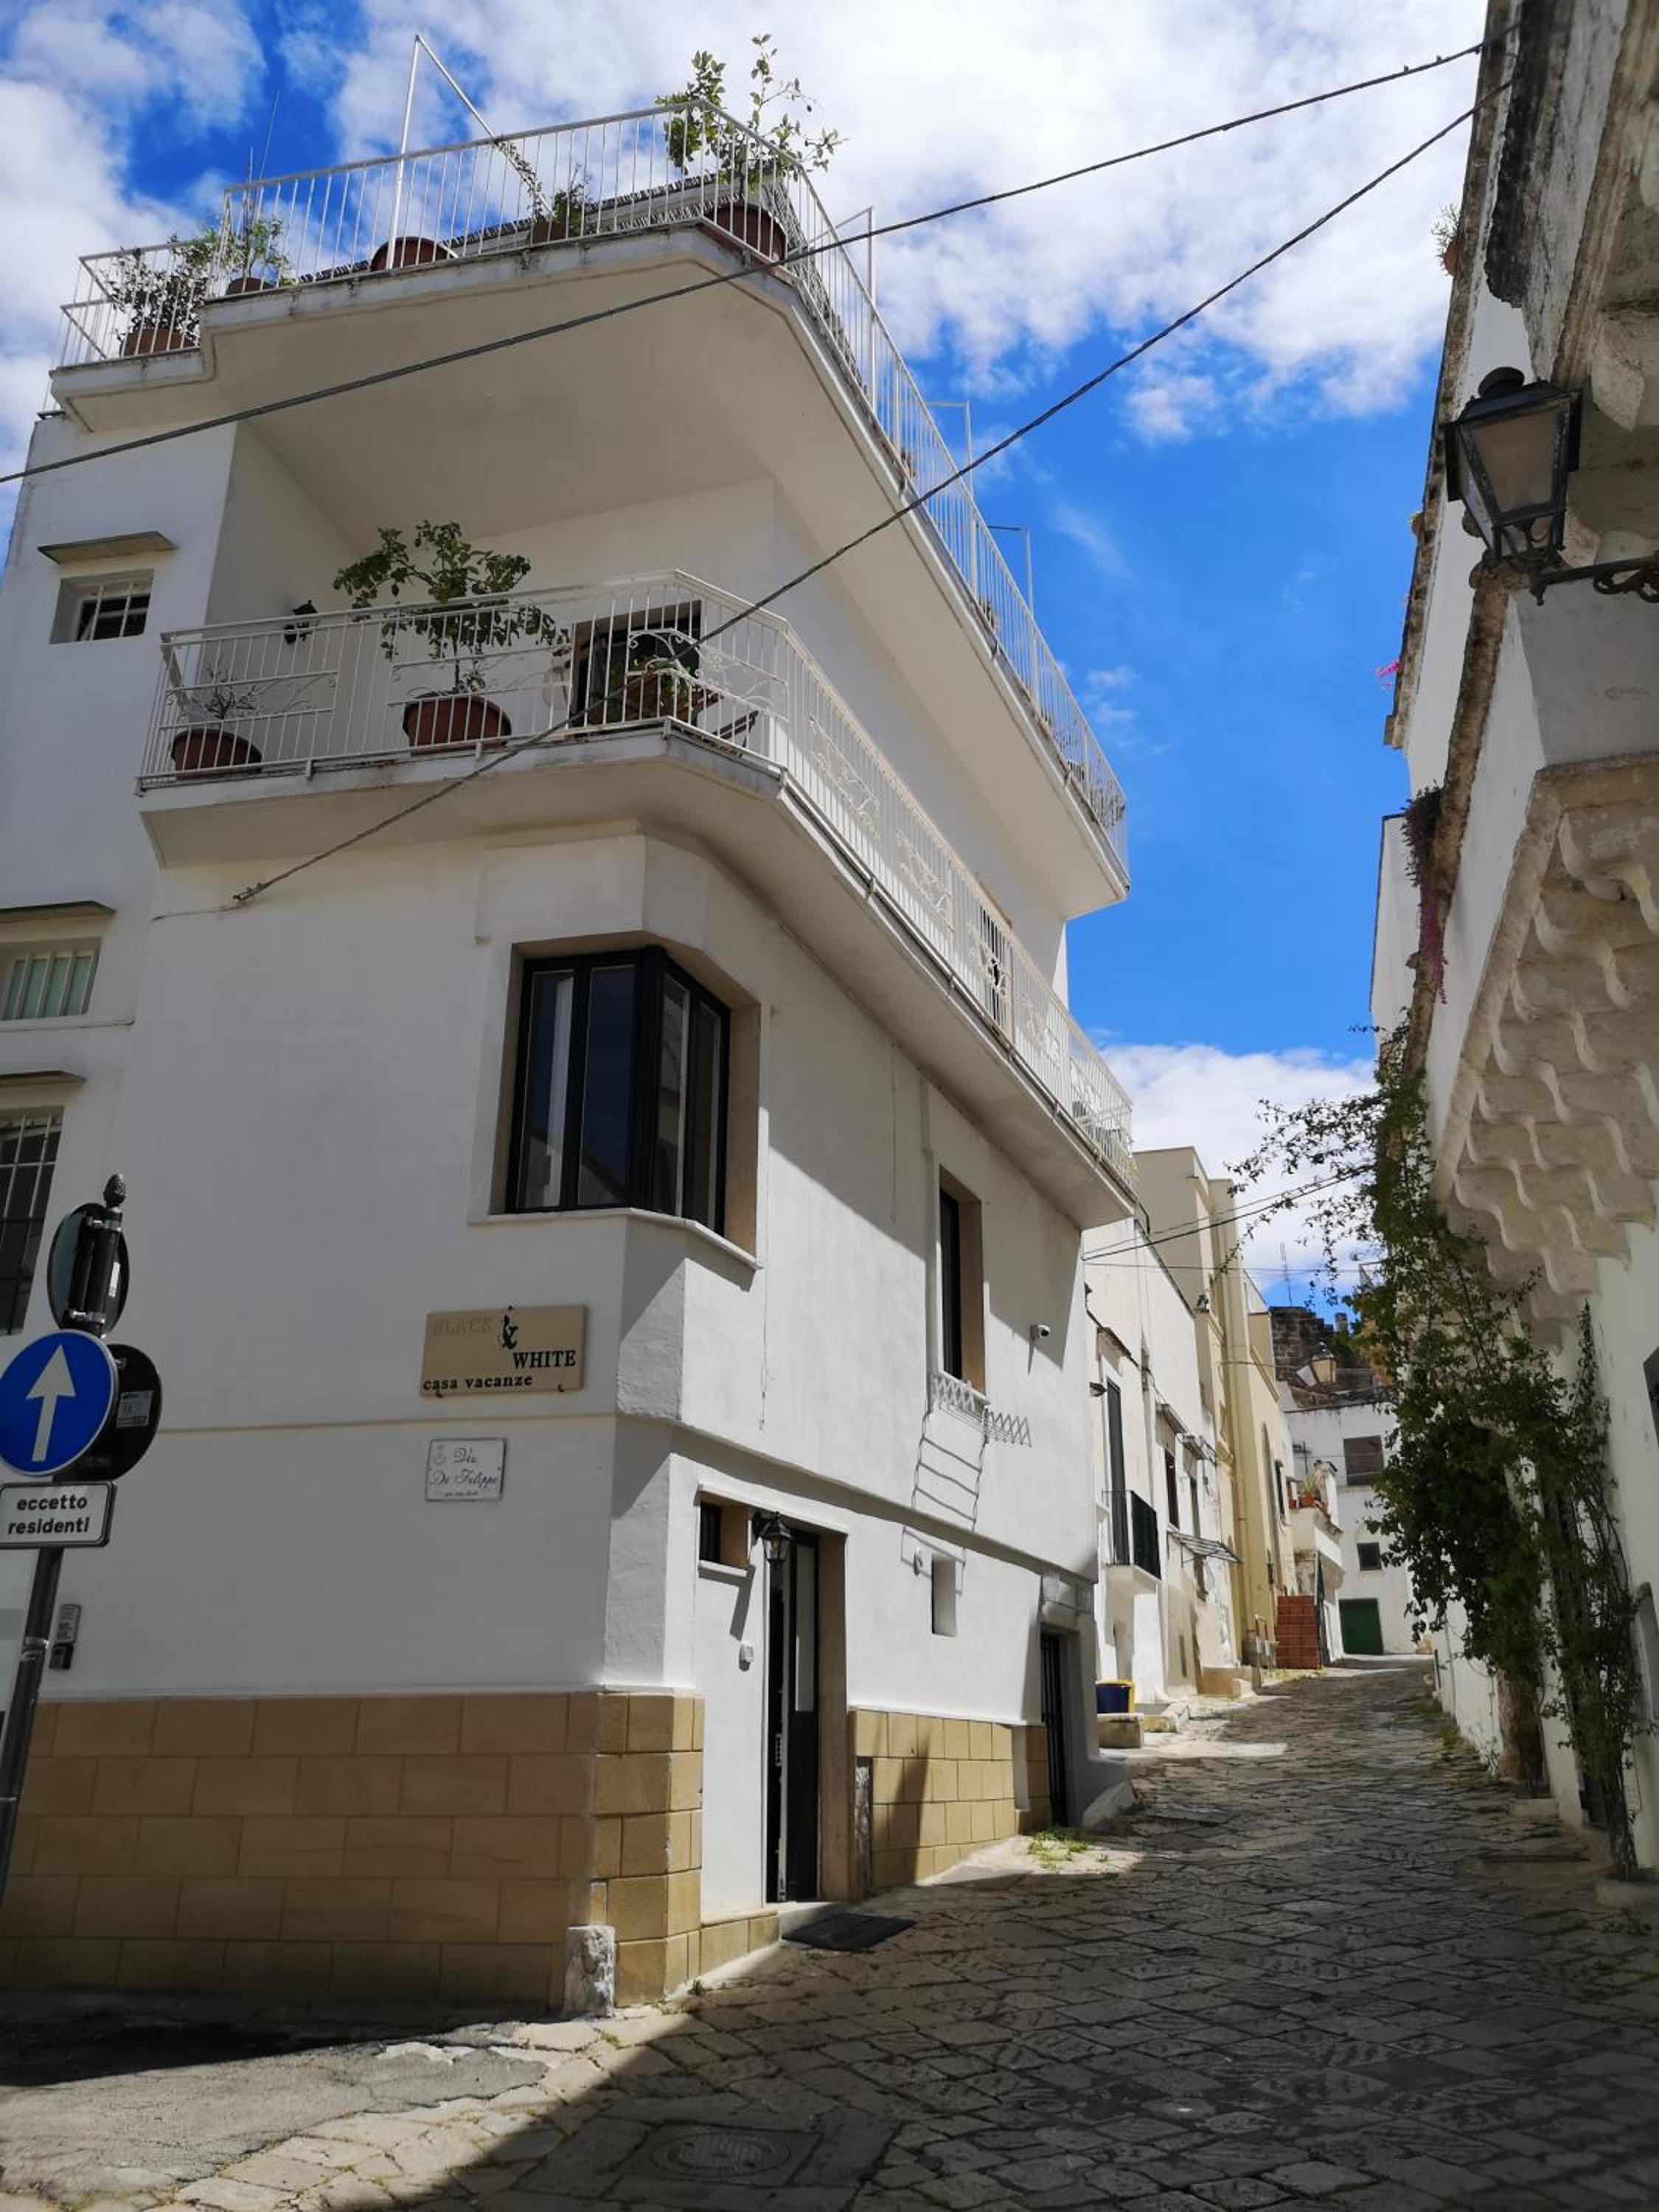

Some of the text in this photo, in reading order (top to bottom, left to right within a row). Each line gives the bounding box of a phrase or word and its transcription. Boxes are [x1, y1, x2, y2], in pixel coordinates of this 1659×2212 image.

[433, 1315, 518, 1349] BLACK &
[513, 1351, 576, 1368] WHITE
[423, 1375, 532, 1391] casa vacanze
[17, 1494, 88, 1510] eccetto
[8, 1517, 90, 1534] residenti
